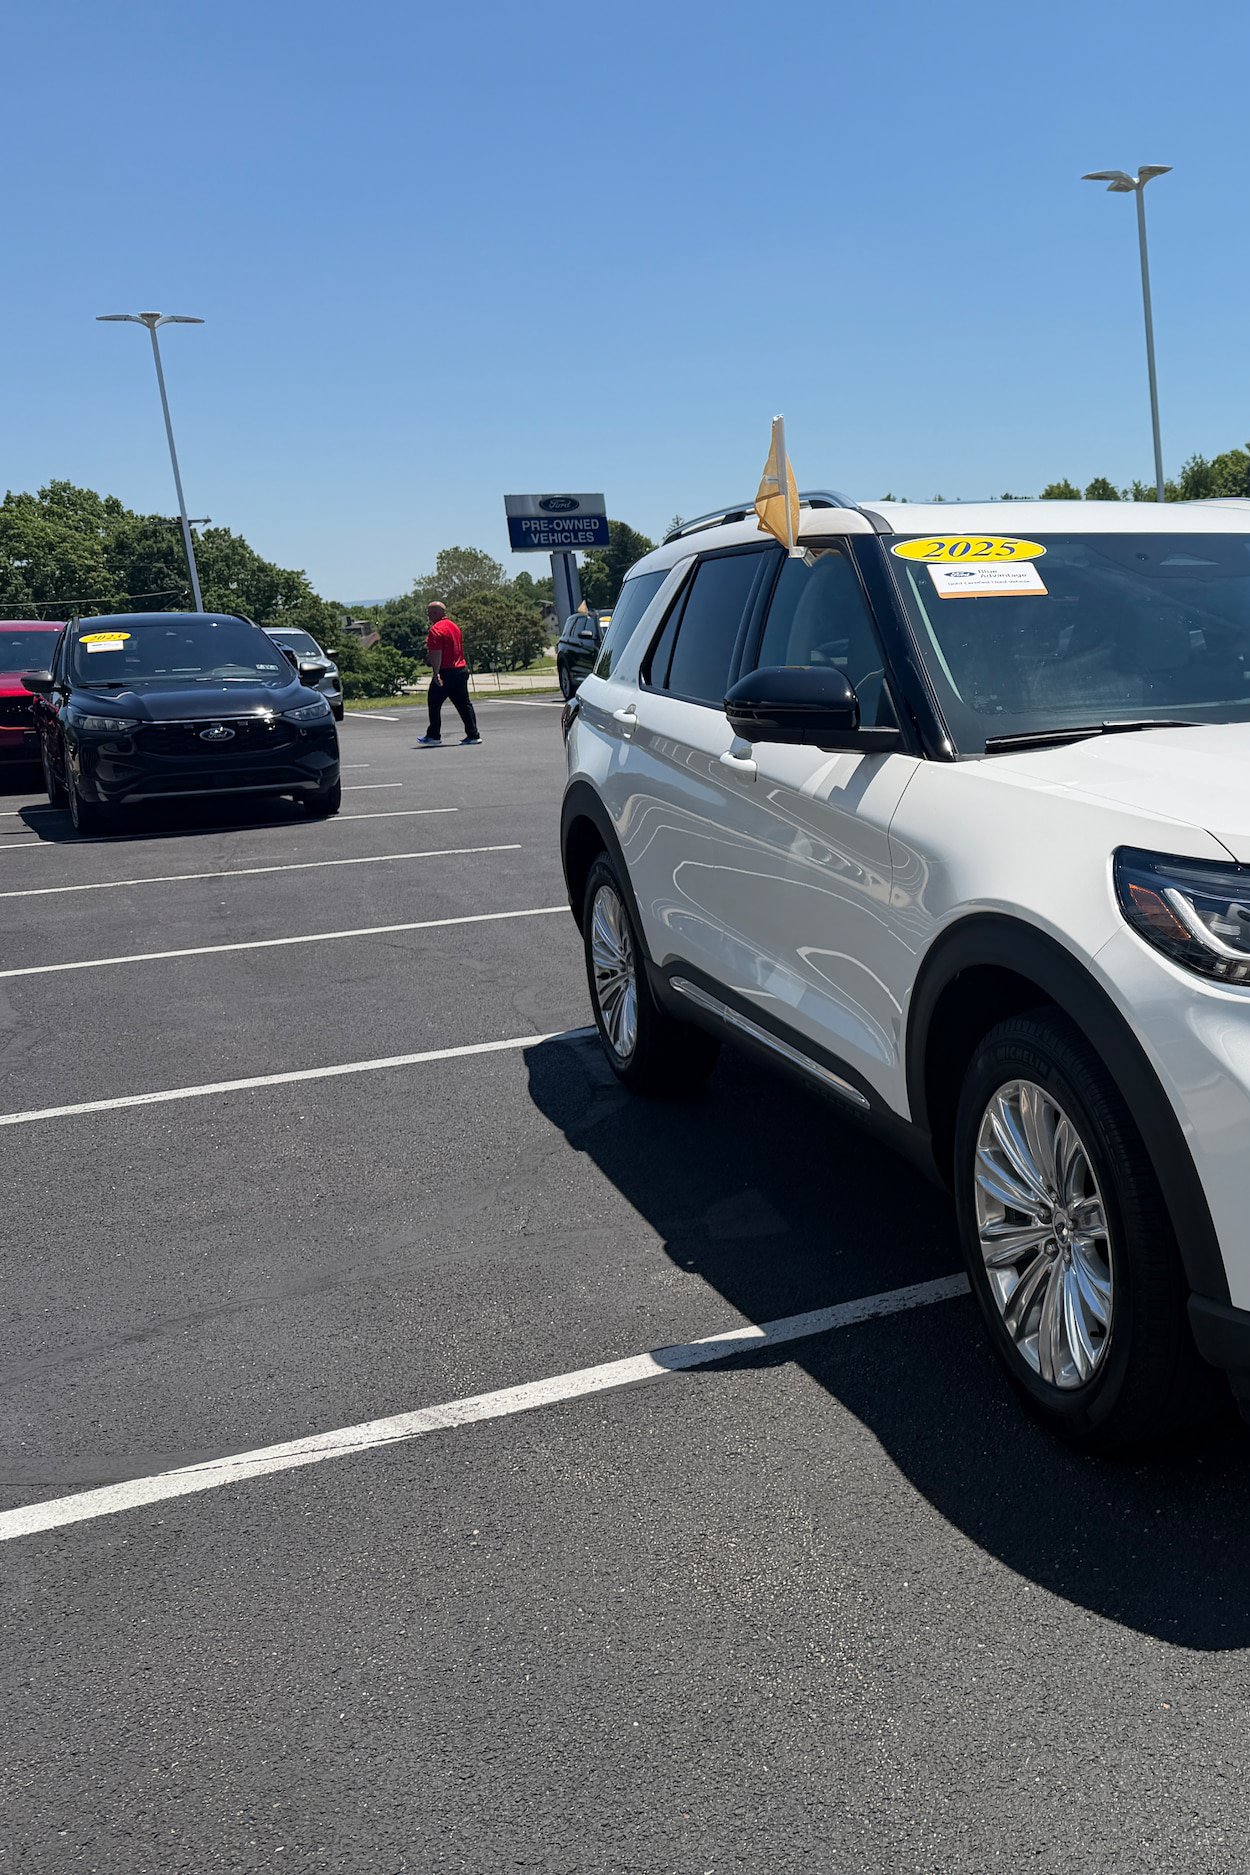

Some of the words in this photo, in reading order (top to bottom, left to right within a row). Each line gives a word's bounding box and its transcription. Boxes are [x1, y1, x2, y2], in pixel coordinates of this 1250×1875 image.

[548, 499, 571, 509] Ford
[521, 519, 600, 531] PRE-OWNED
[531, 532, 595, 544] VEHICLES
[922, 541, 1018, 558] 2025
